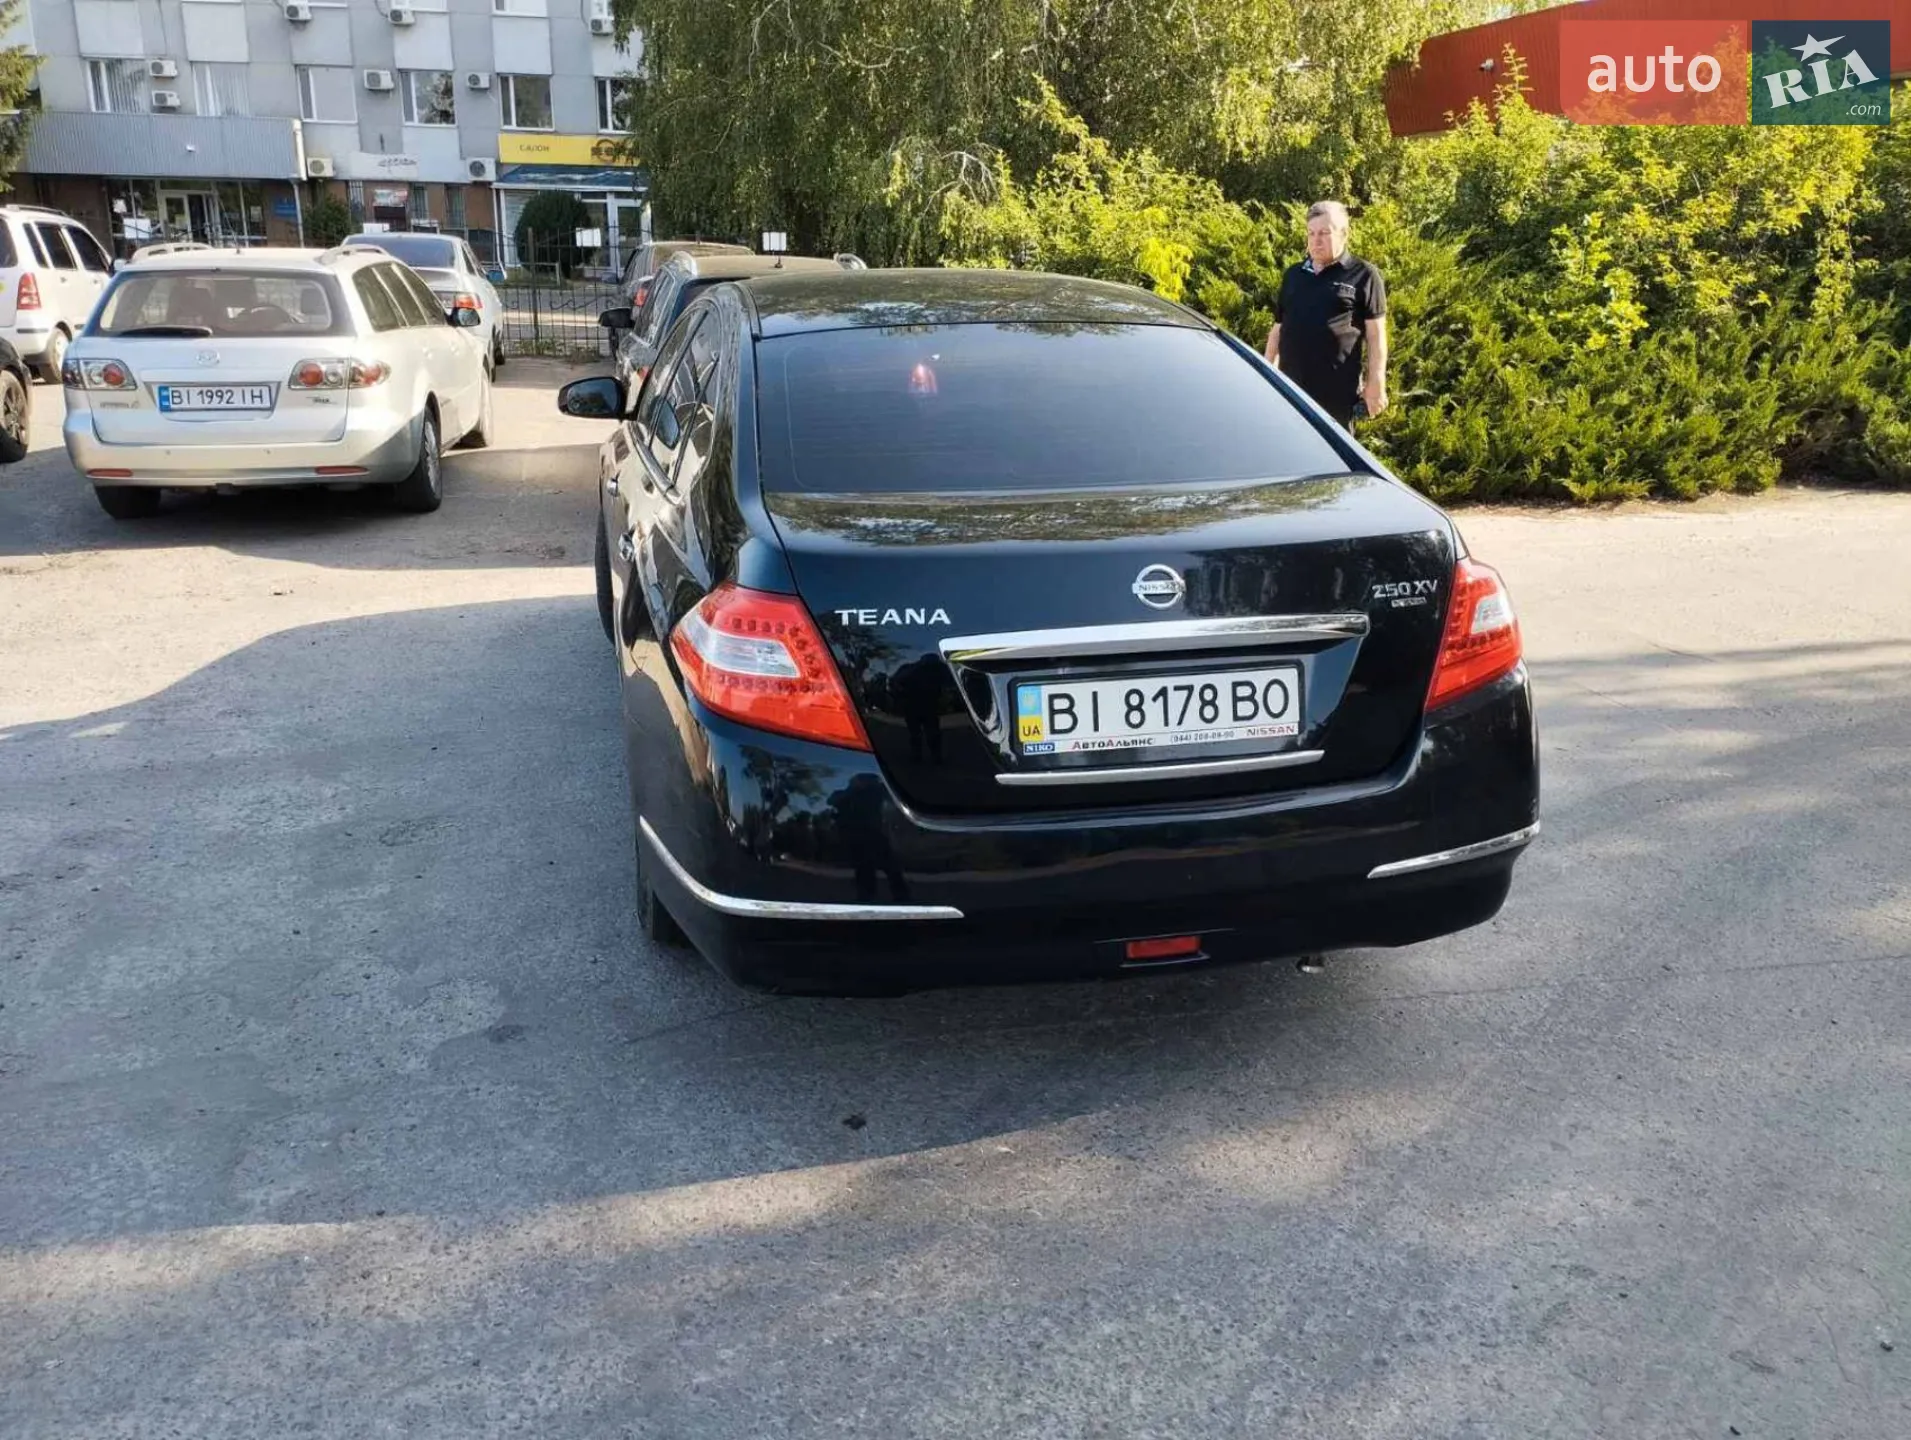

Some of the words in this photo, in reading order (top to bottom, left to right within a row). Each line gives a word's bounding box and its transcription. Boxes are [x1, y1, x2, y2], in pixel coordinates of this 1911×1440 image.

[171, 389, 191, 405] BI
[197, 389, 235, 405] 1992
[241, 388, 264, 404] IH
[1371, 582, 1411, 599] 250
[1413, 579, 1438, 595] XV
[834, 607, 952, 626] TEANA
[1048, 690, 1100, 735] BI
[1124, 682, 1220, 730] 8178
[1231, 678, 1290, 723] BO
[1022, 724, 1041, 737] UA
[1246, 725, 1296, 737] NISSAN
[1025, 744, 1054, 753] NIKO
